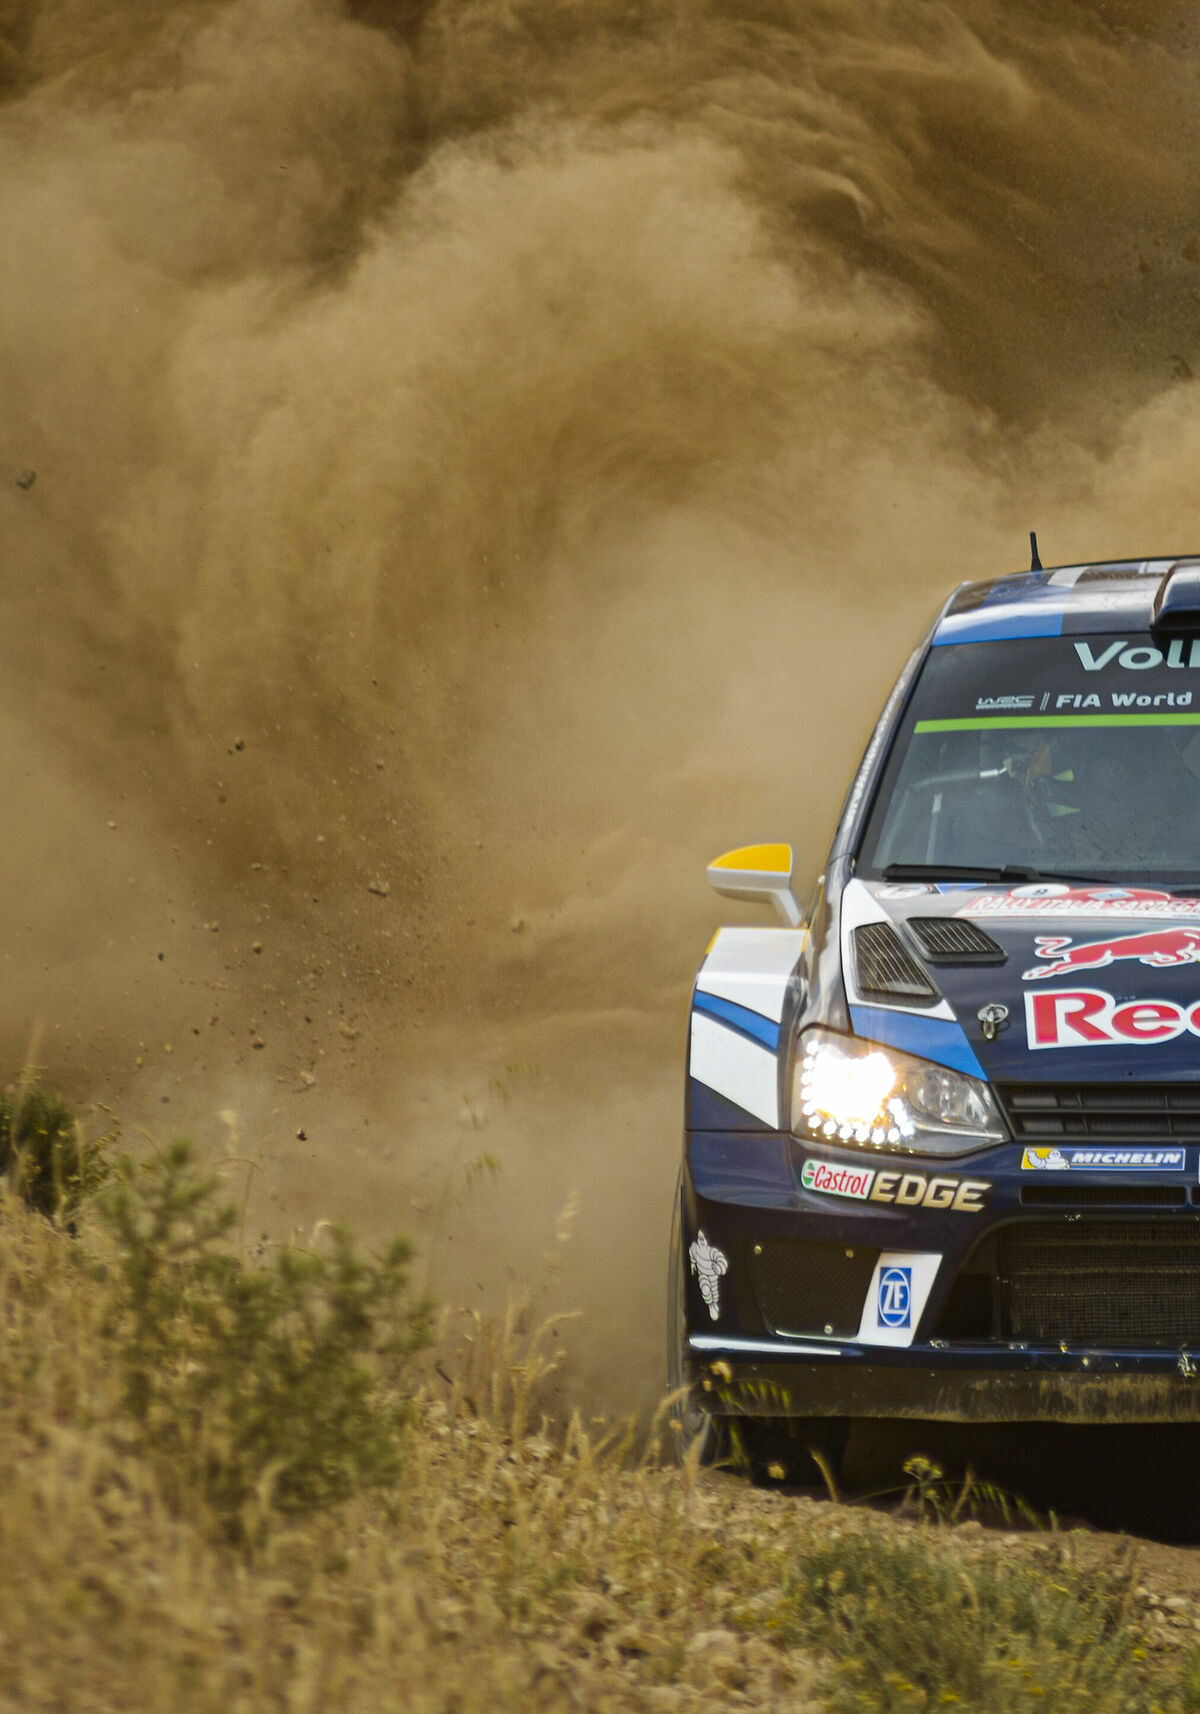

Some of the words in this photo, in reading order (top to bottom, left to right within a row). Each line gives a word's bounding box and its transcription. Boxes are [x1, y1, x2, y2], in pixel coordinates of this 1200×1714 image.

[1055, 693, 1101, 708] FIA
[1111, 691, 1193, 708] World
[971, 896, 1033, 910] RALLY
[1070, 1149, 1182, 1165] MICHELIN
[814, 1164, 870, 1196] Castrol
[868, 1171, 993, 1213] EDGE
[881, 1280, 907, 1315] ZF
